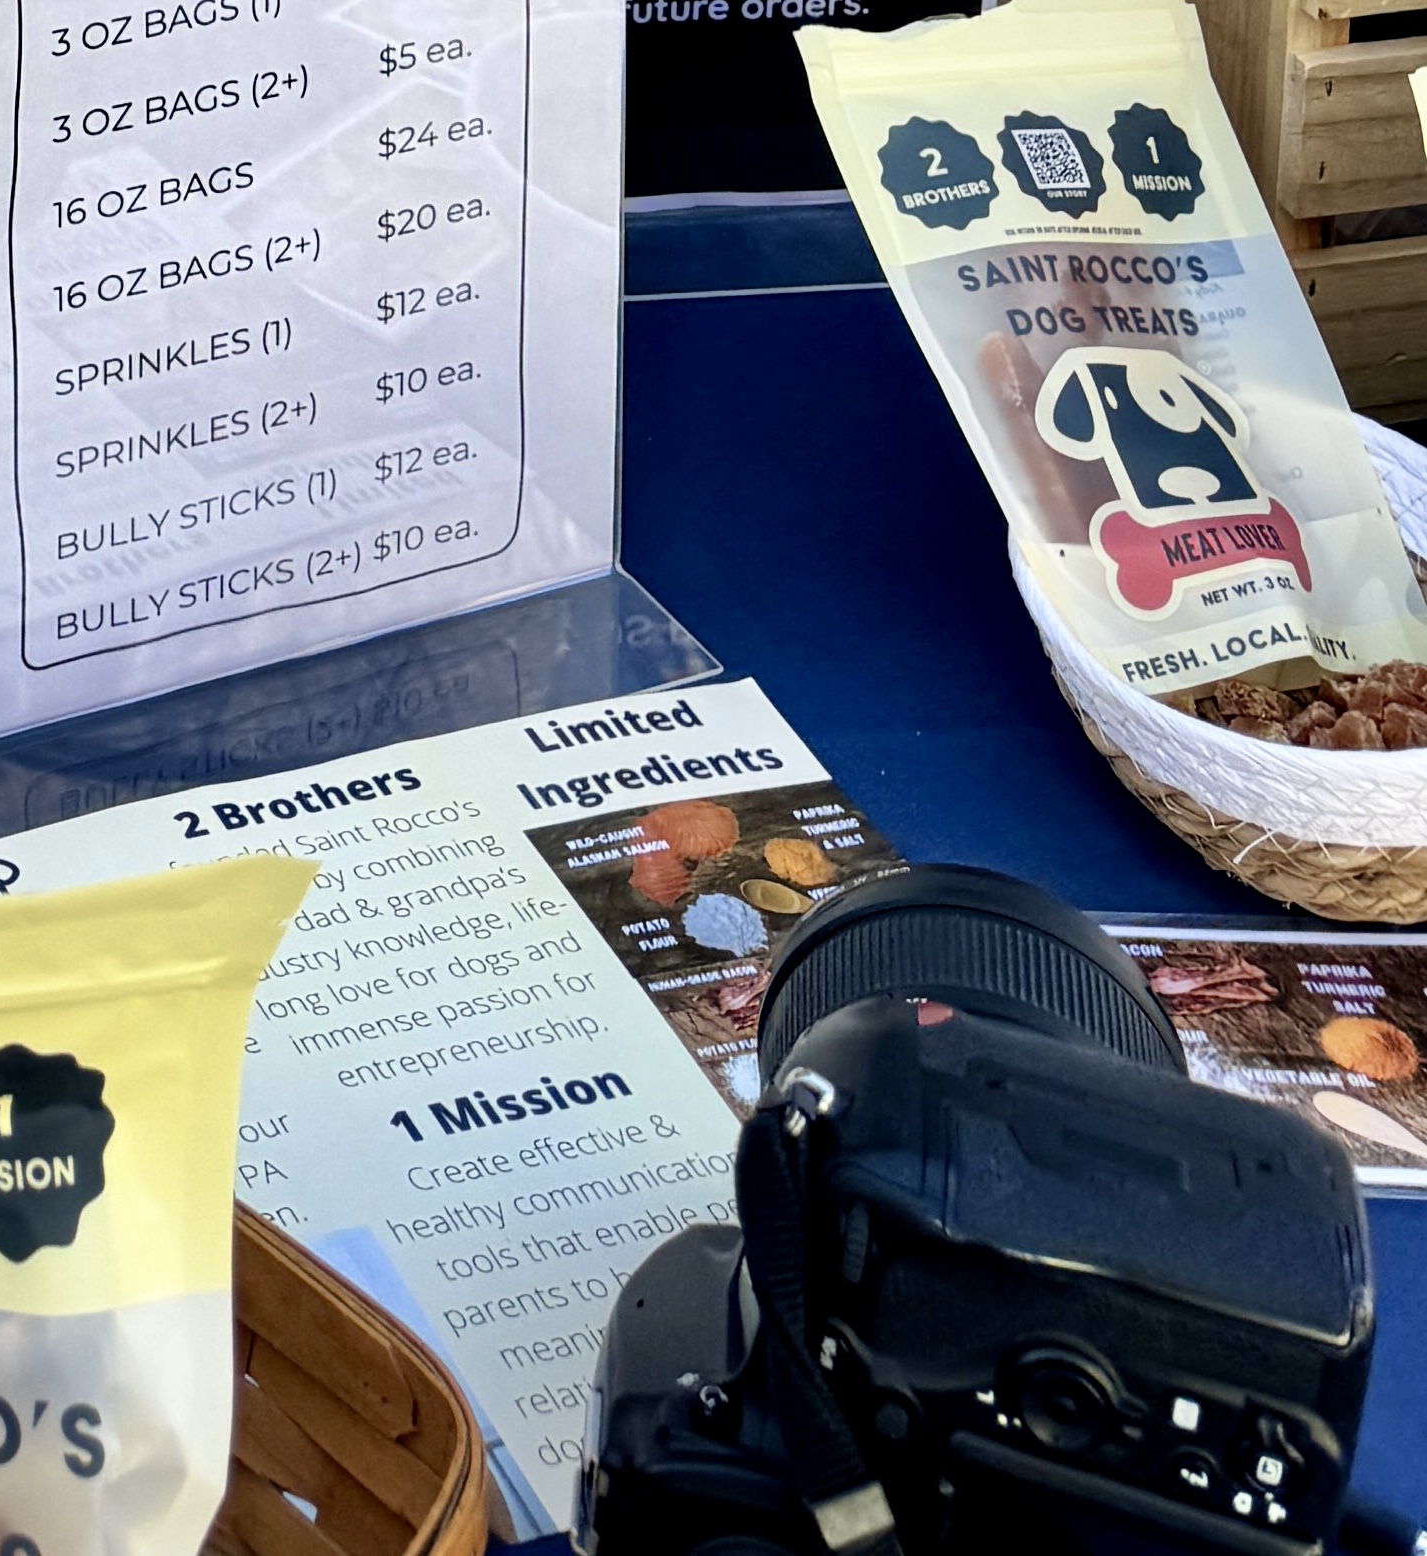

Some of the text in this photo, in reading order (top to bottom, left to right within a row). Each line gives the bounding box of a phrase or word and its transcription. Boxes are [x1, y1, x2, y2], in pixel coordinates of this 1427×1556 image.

[53, 118, 492, 228] 16 OZ BAGS $24 ea.
[958, 254, 1209, 292] SAINT ROCCO'S
[1006, 306, 1199, 337] DOG TREATS
[58, 442, 477, 560] BULLY STICKS (1) $12 ea.
[1162, 524, 1285, 568] MEAT LOVER
[1122, 623, 1307, 683] FRESH. LOCAL.
[525, 700, 704, 753] Limited
[173, 768, 421, 839] 2 Brothers
[518, 749, 784, 810] Ingredients
[295, 800, 481, 855] Saint Rocco's
[353, 835, 505, 880] combining
[294, 867, 526, 931] dad & grandpa's
[344, 898, 566, 960] knowledge, life-
[1297, 963, 1373, 979] PAPRIKA
[338, 1011, 609, 1087] entrepreneurship.
[390, 1073, 633, 1142] 1 Mission
[407, 1114, 681, 1191] Create effective &
